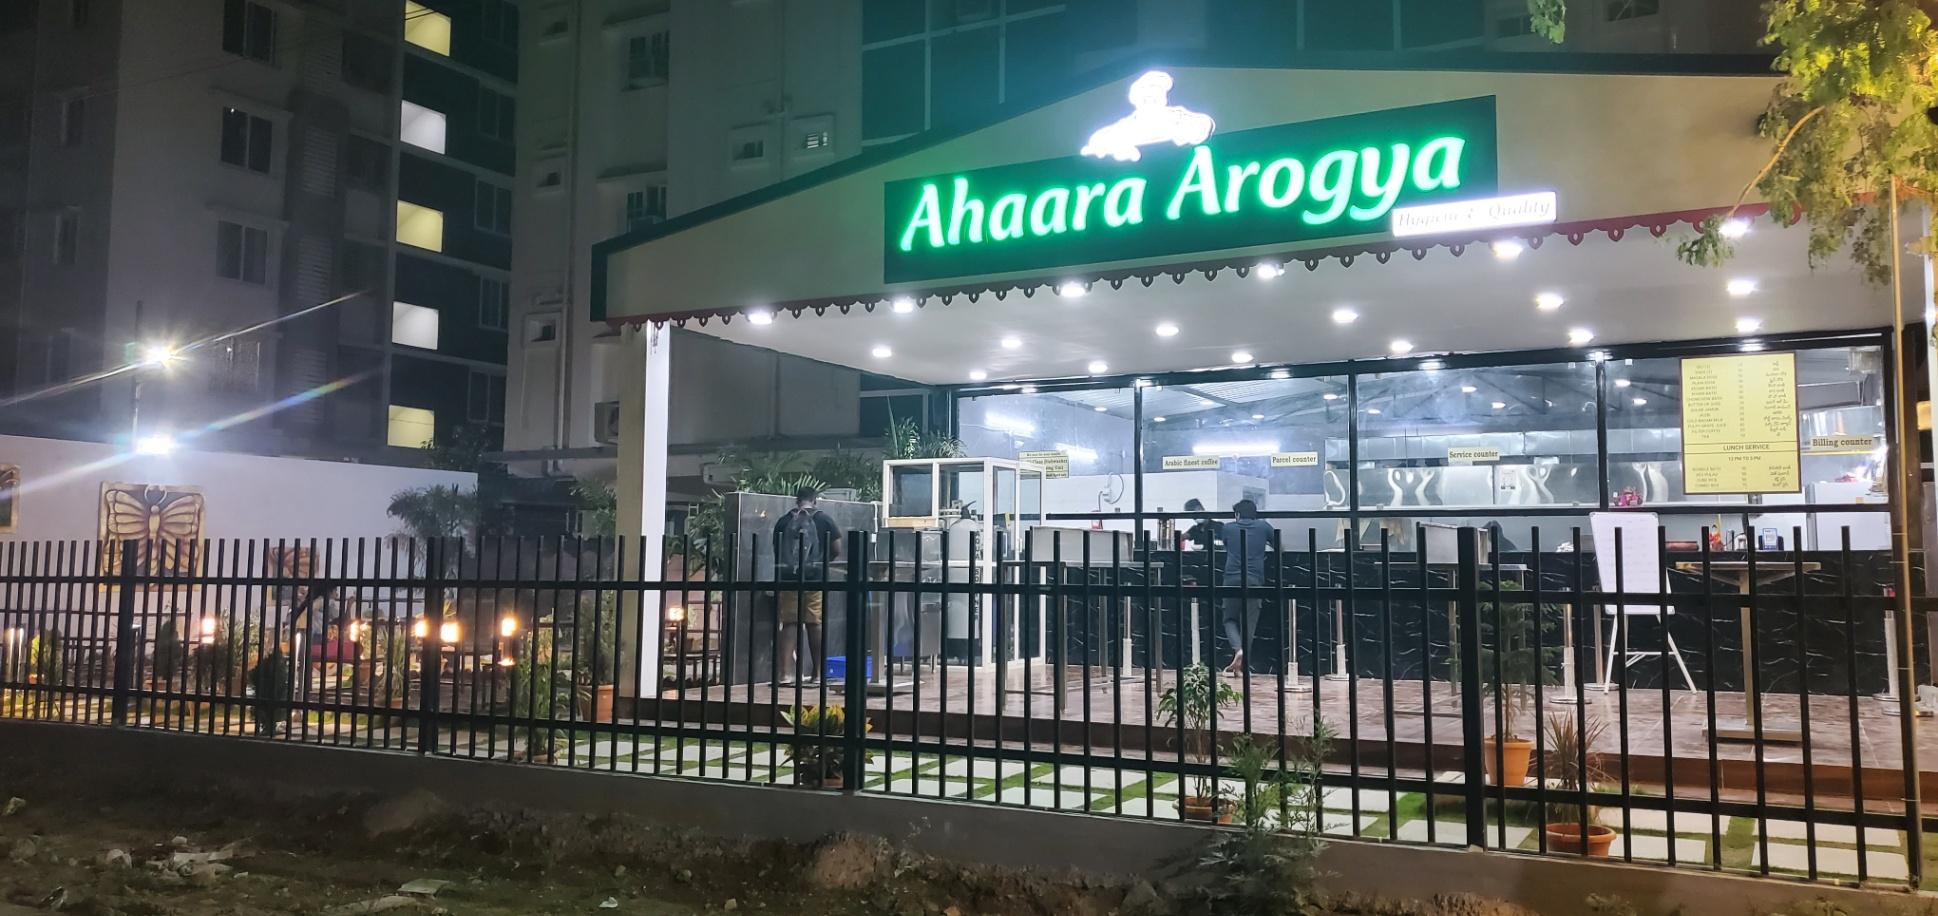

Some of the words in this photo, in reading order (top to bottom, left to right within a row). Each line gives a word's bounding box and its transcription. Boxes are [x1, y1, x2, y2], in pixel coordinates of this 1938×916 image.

[900, 176, 1147, 252] Ahaara
[1166, 136, 1466, 226] Arogya
[1488, 200, 1551, 220] Quality
[1812, 438, 1838, 448] Billing
[1840, 437, 1872, 446] counter
[1449, 451, 1472, 459] Service
[1474, 450, 1498, 458] counter
[1165, 459, 1183, 467] Arabic
[1184, 459, 1200, 467] finest
[1201, 458, 1218, 466] coffee
[1272, 456, 1291, 464] Parcel
